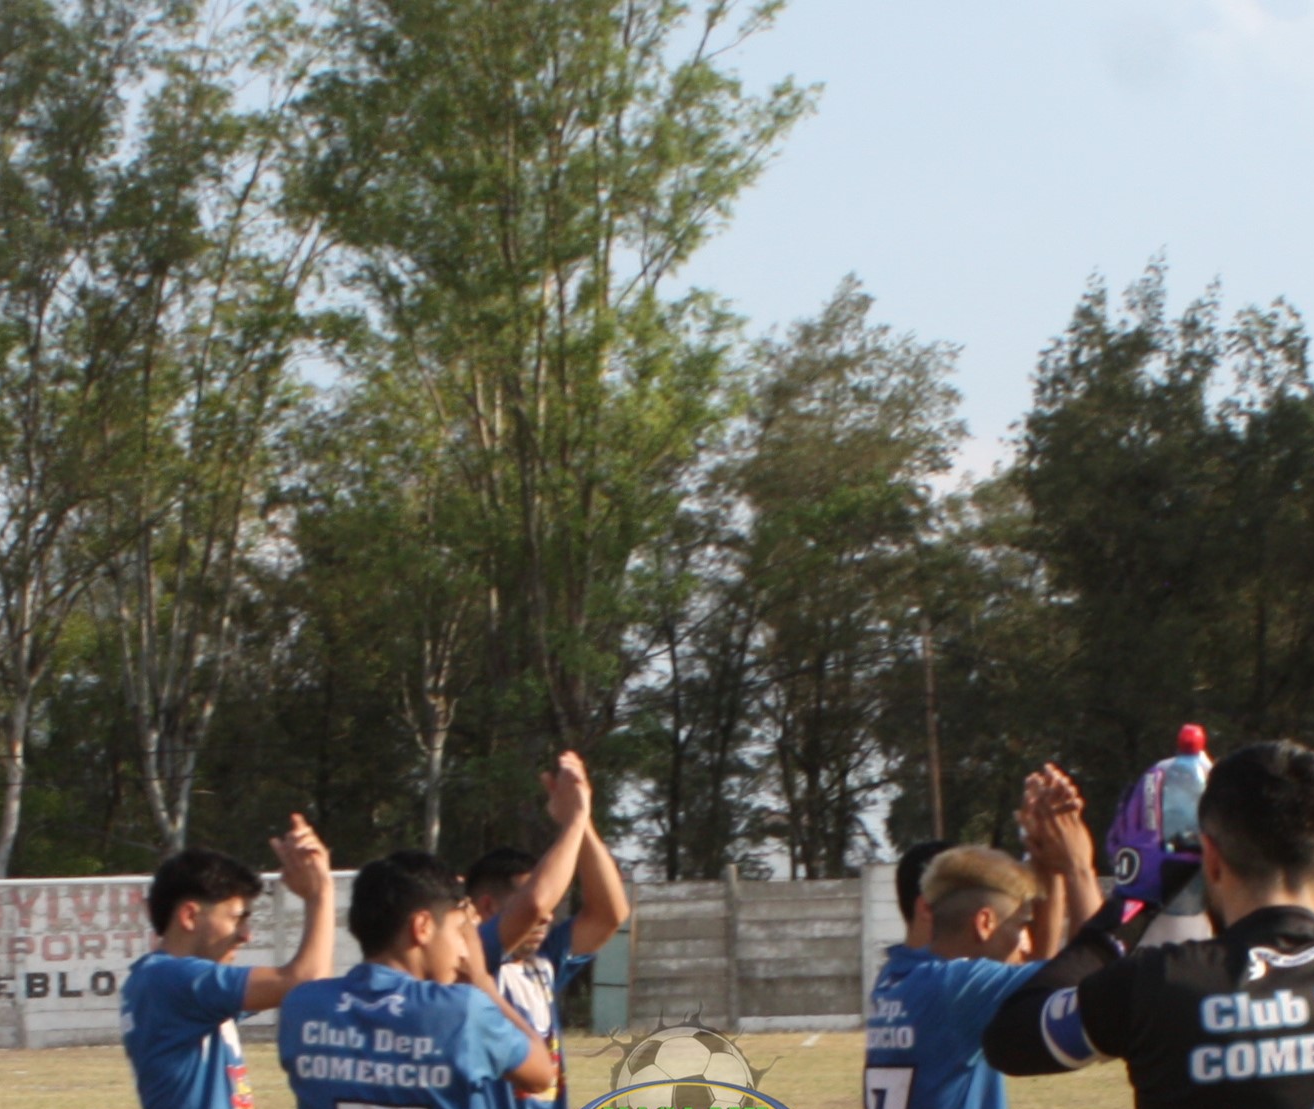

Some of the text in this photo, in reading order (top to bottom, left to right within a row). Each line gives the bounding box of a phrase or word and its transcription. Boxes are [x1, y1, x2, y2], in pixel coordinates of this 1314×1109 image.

[1200, 992, 1310, 1033] Club
[302, 1020, 442, 1059] Club Dep.
[296, 1055, 452, 1088] COMERCIO
